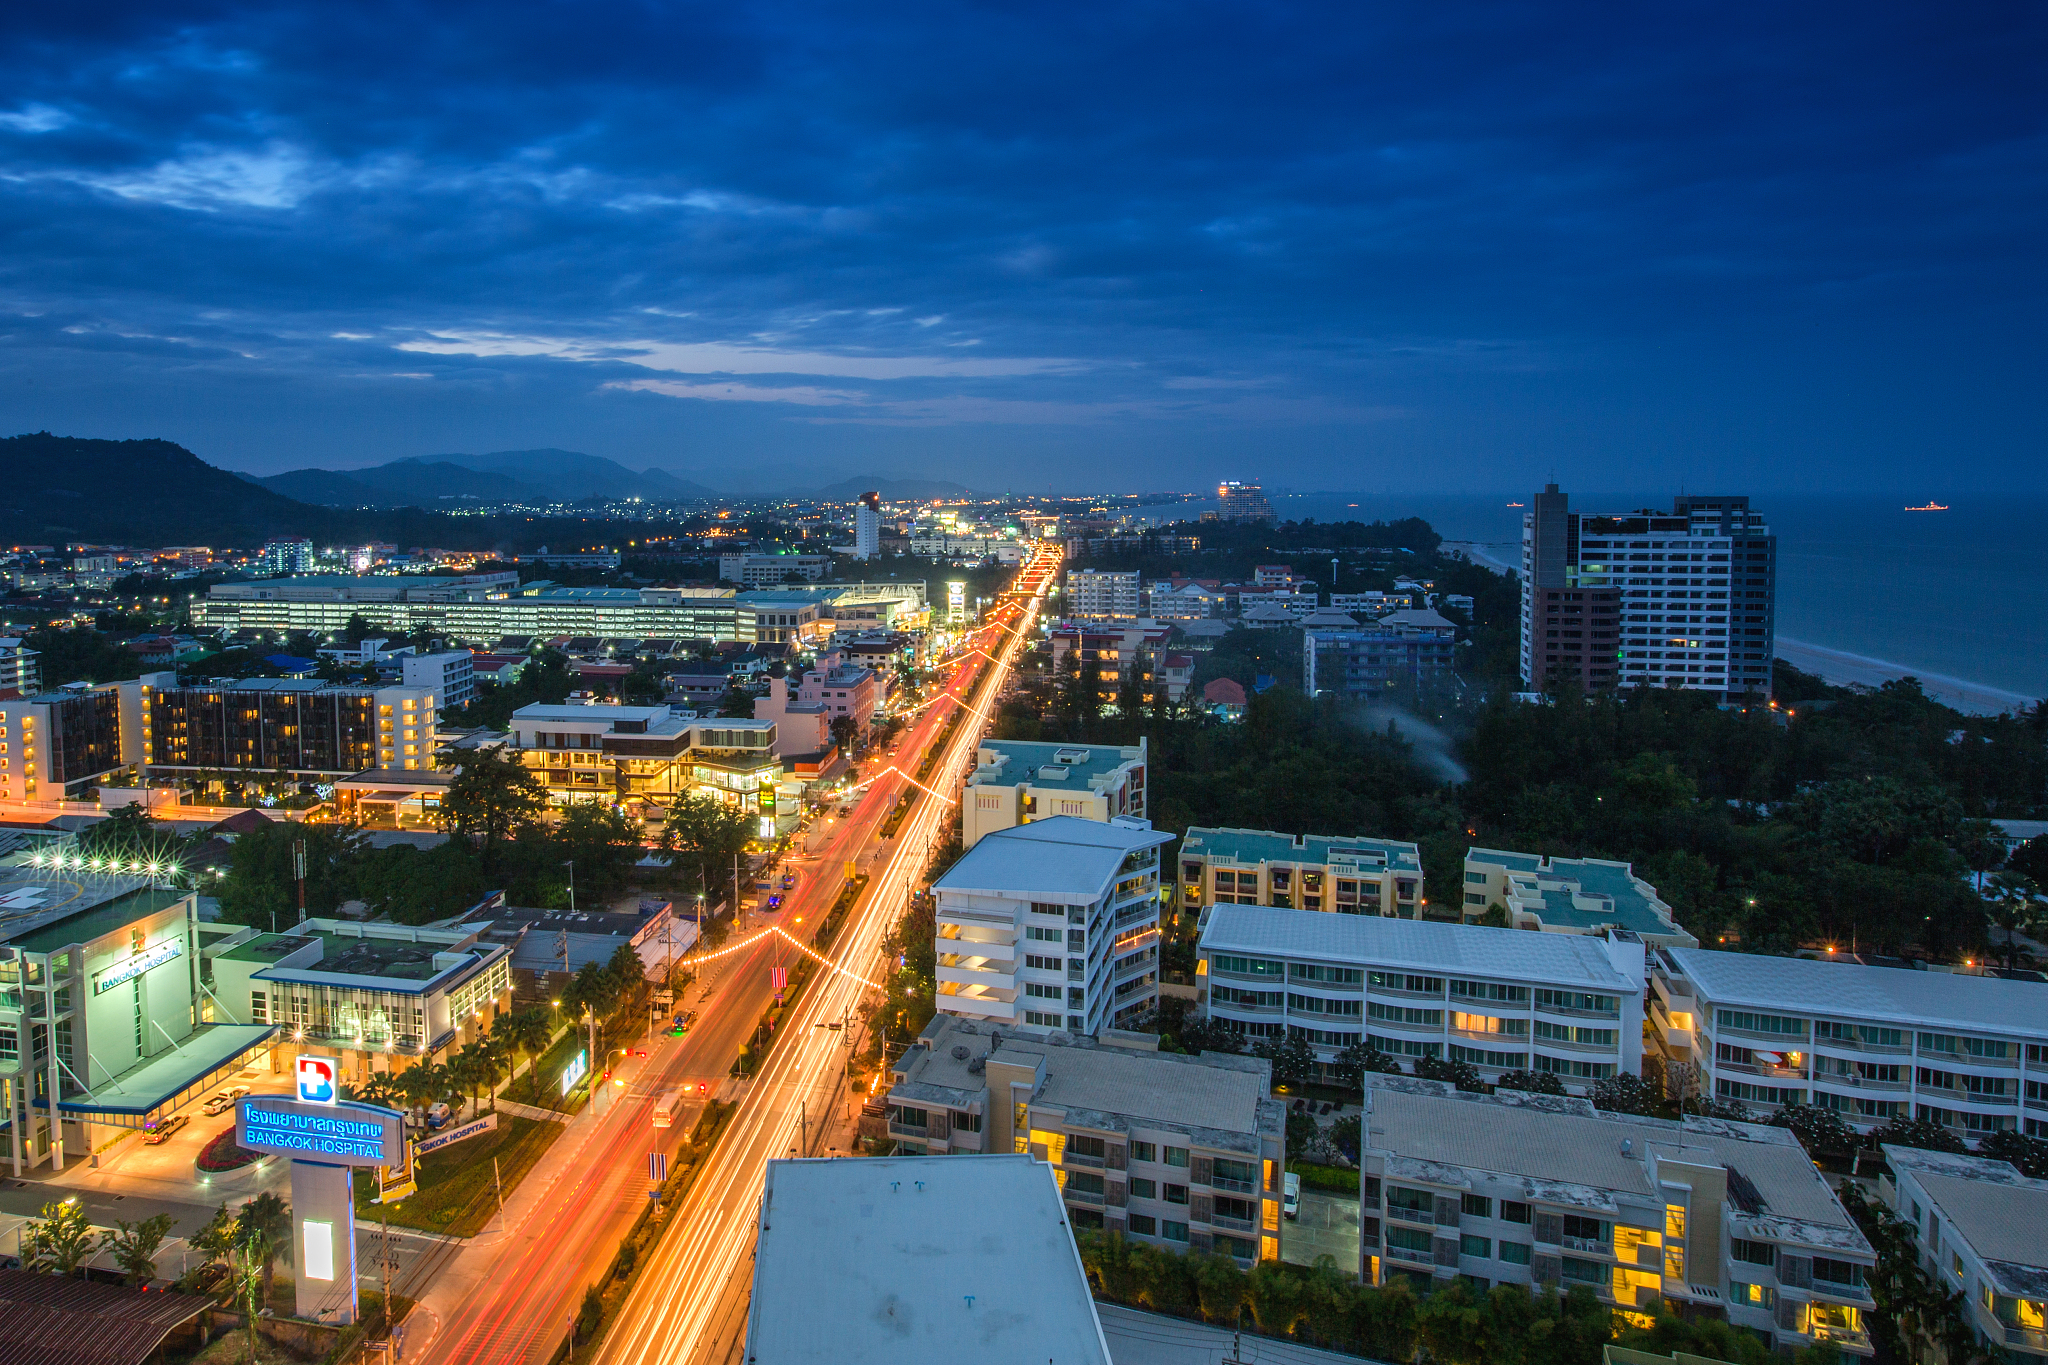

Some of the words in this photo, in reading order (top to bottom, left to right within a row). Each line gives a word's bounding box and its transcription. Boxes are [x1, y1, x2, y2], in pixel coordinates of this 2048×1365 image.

[102, 966, 141, 990] BANGKOK
[144, 947, 181, 970] HOSPITAL
[244, 1103, 383, 1137] โรงพยาบาลกรุงเทพ
[450, 1121, 489, 1142] HOSPITAL
[246, 1130, 312, 1150] BANGKOK
[315, 1139, 384, 1159] HOSPITAL
